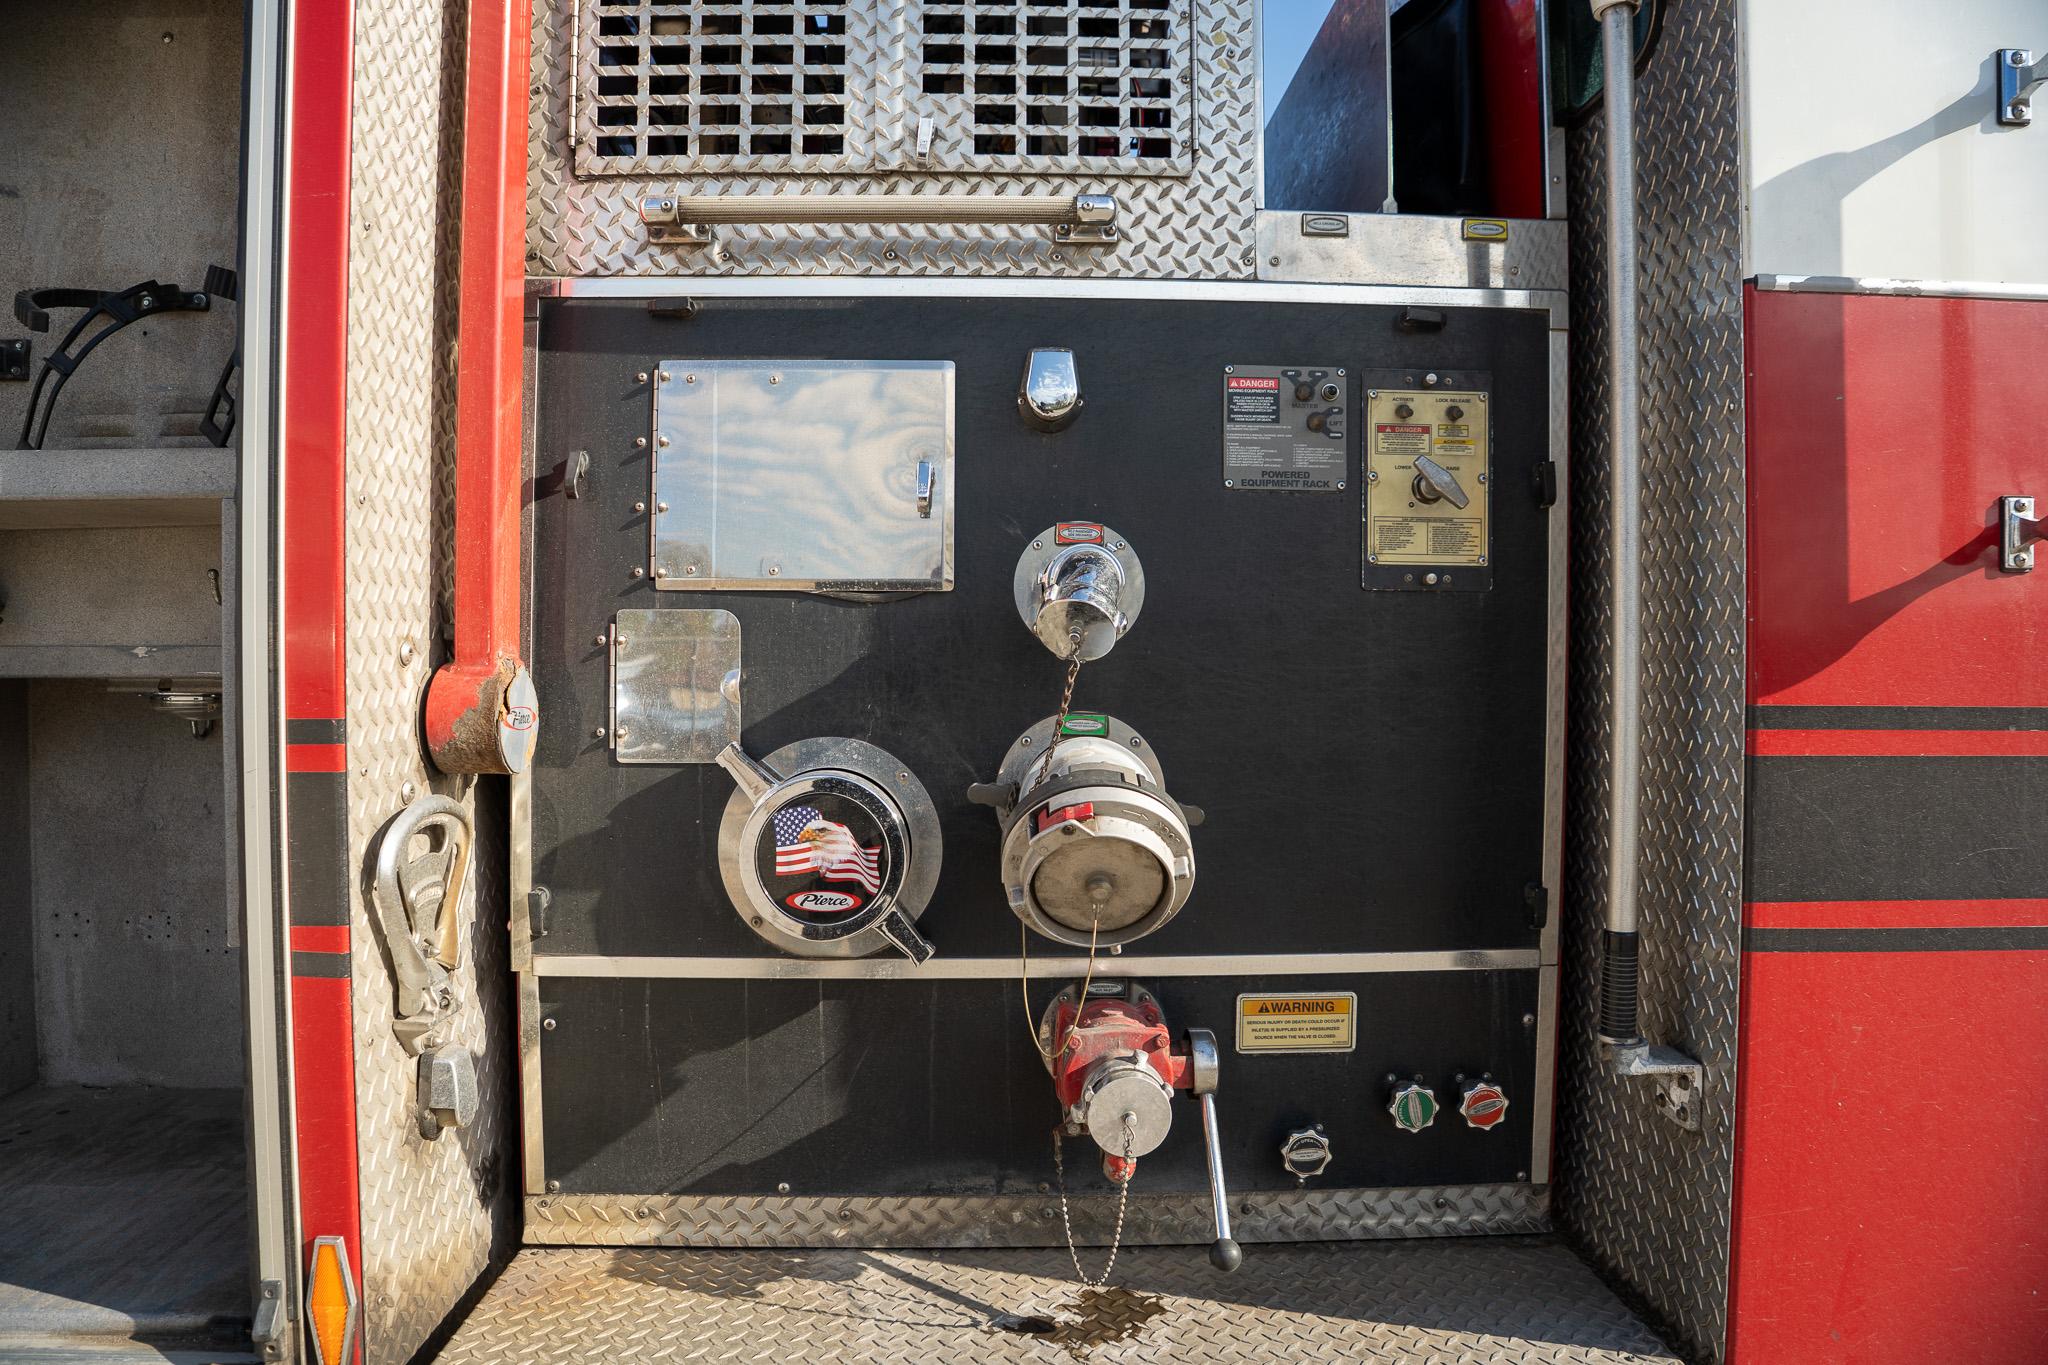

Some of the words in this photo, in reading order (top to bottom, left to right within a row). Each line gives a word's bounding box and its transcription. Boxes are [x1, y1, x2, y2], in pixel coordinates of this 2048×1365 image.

[1240, 379, 1275, 388] DANGER
[1261, 471, 1310, 479] POWERED
[1241, 479, 1300, 488] EQUIPMENT
[1303, 479, 1330, 488] RACK
[799, 894, 848, 906] Pierce
[1270, 1001, 1335, 1013] WARNING
